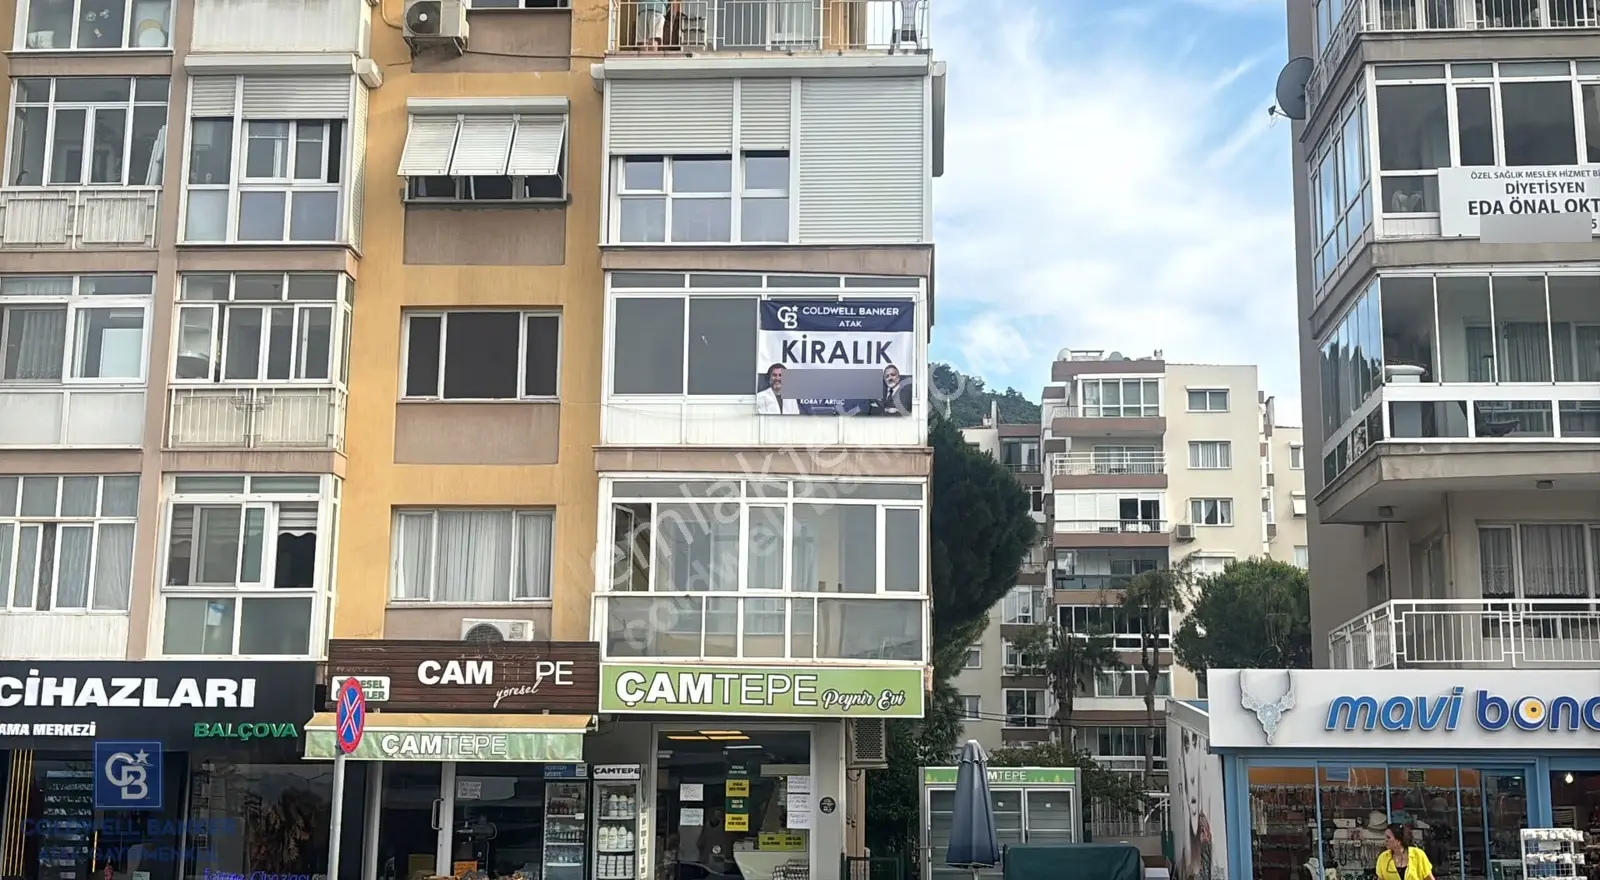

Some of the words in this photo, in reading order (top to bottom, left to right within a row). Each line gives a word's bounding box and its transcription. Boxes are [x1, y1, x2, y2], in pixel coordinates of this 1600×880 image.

[1471, 171, 1492, 179] ÖZEL
[1494, 170, 1523, 179] SAĞLIK
[1525, 170, 1557, 178] MESLEK
[1560, 168, 1590, 178] HİZMET
[1505, 180, 1585, 194] DİYETİSYEN
[1468, 200, 1504, 215] EDA
[1509, 196, 1560, 214] ÖNAL
[802, 306, 856, 316] COLDWELL
[859, 307, 899, 316] BANKER
[839, 320, 862, 328] ATAK
[782, 334, 893, 364] KİRALIK
[0, 669, 256, 708] CİHAZLARI
[615, 671, 818, 707] ÇAMTEPE
[821, 688, 876, 712] Peynir
[877, 689, 906, 711] Evi
[1325, 685, 1465, 731] mavi
[33, 721, 96, 737] MERKEZİ
[194, 723, 299, 741] BALÇOVA
[381, 733, 507, 757] ÇAMTEPE
[594, 767, 641, 775] ÇAMTEPE
